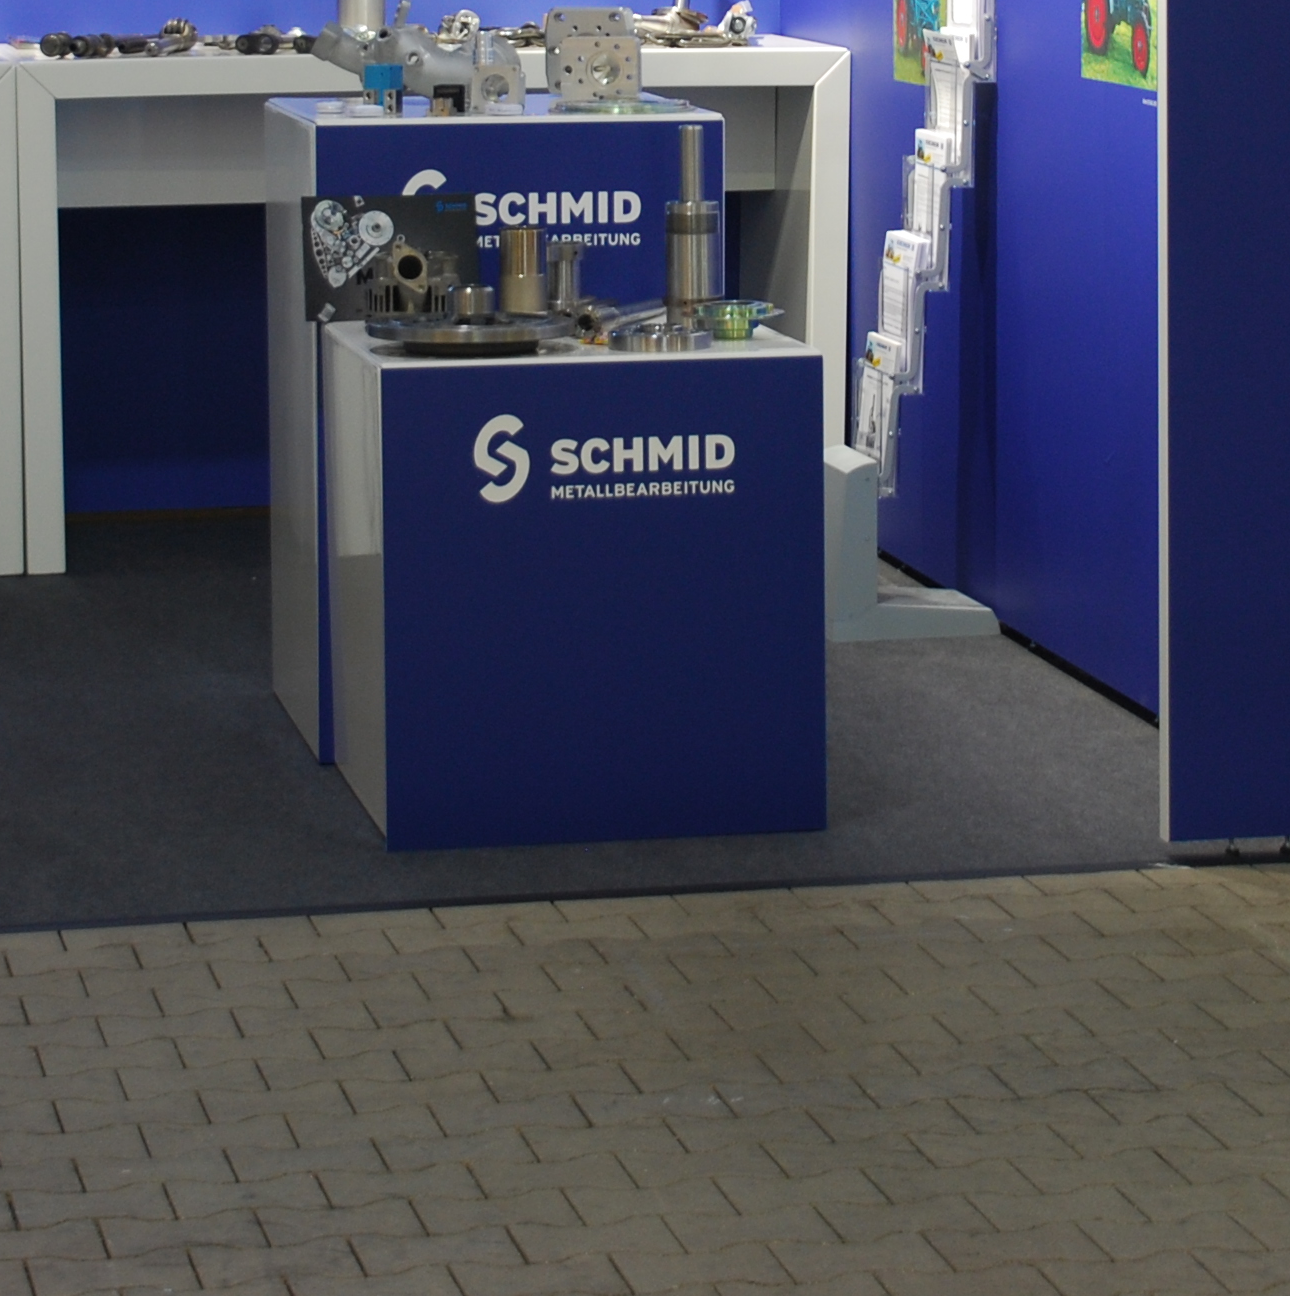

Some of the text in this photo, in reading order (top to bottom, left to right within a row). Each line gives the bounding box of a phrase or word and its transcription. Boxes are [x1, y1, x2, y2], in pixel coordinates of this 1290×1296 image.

[474, 190, 642, 226] SCHMID
[550, 434, 736, 475] SCHMID
[551, 479, 736, 500] METALLBEARBEITUNG
